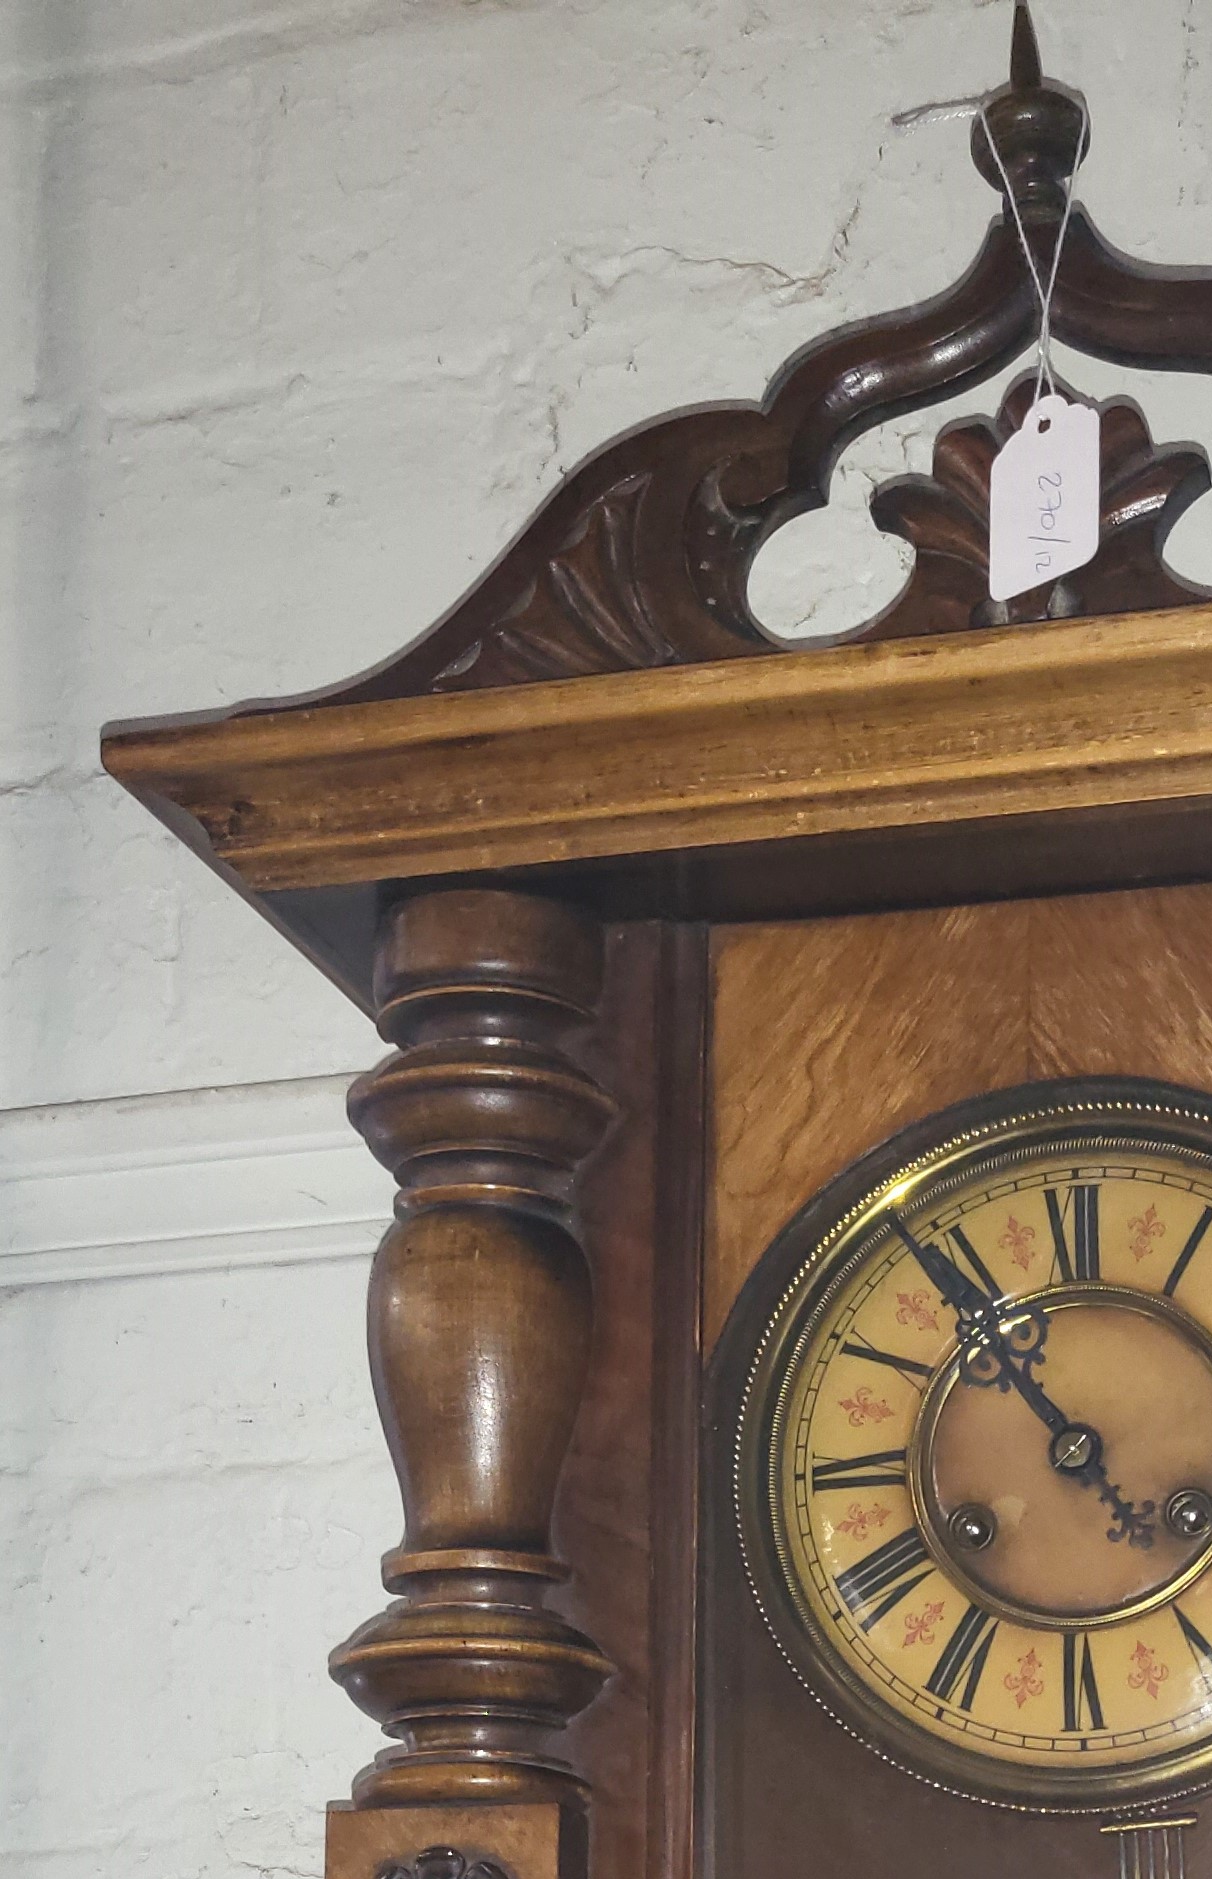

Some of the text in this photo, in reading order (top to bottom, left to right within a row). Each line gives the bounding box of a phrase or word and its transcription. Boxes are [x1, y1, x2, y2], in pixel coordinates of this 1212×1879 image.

[1044, 1184, 1102, 1284] XII
[839, 1327, 936, 1396] X
[812, 1450, 908, 1492] IX
[833, 1528, 936, 1635] VIII
[922, 1604, 1000, 1713] VII
[1063, 1632, 1106, 1732] VI
